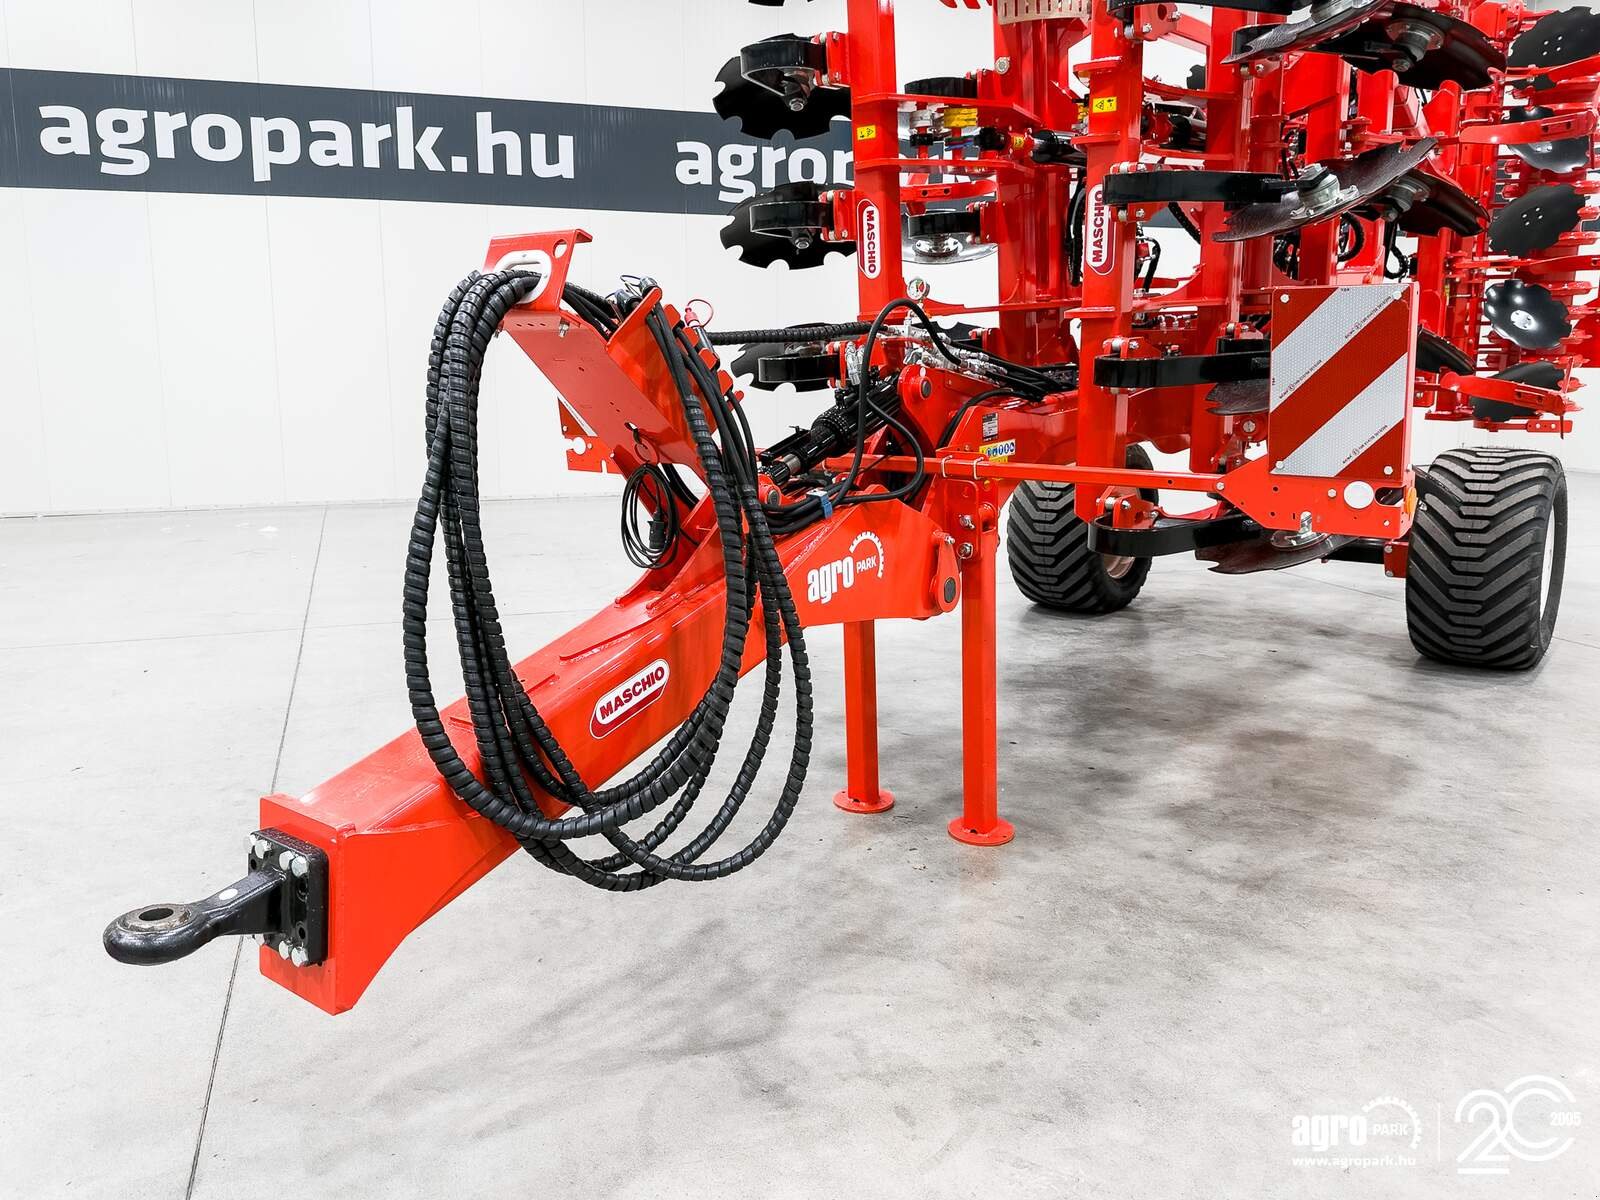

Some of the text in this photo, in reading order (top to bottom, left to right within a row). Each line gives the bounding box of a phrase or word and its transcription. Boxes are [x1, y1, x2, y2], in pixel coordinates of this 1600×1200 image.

[39, 105, 575, 182] agropark.hu
[866, 209, 877, 274] MASCHIO
[807, 555, 877, 605] agro PARK
[599, 666, 665, 720] MASCHIO
